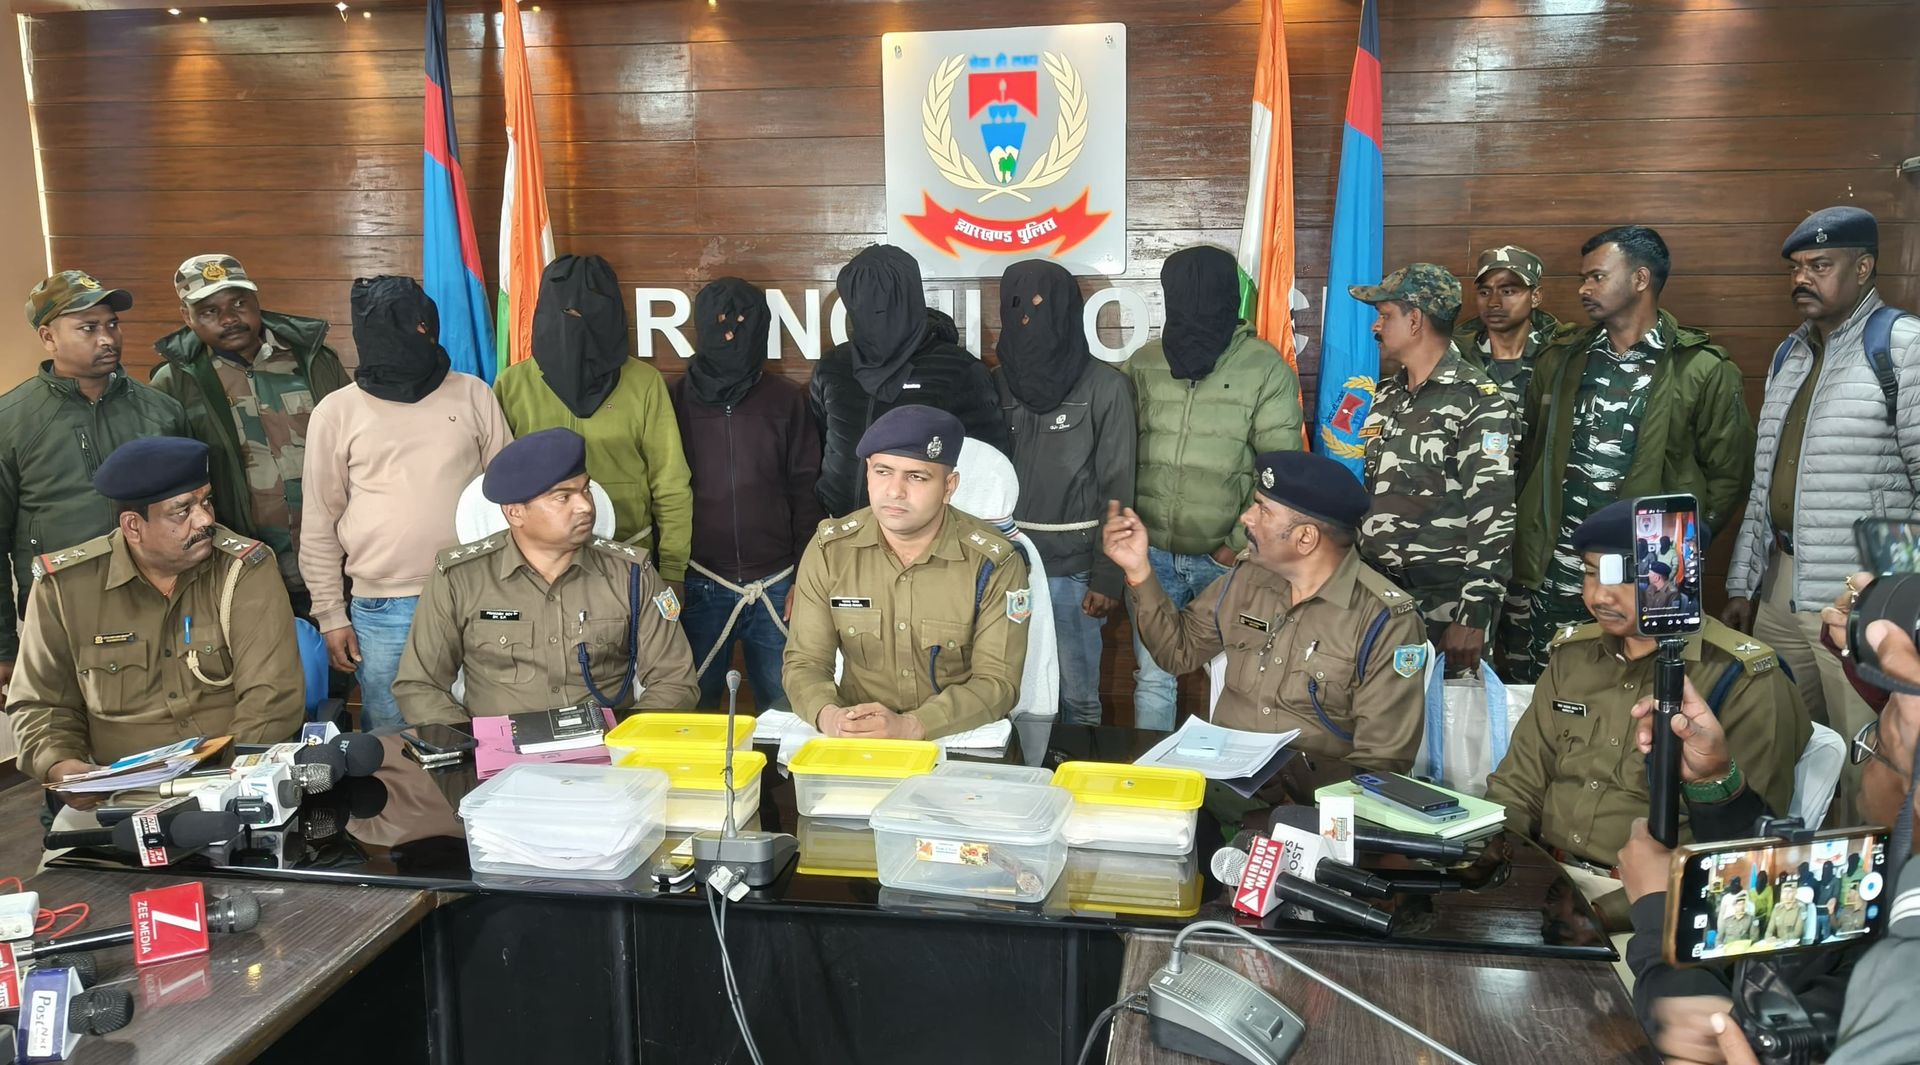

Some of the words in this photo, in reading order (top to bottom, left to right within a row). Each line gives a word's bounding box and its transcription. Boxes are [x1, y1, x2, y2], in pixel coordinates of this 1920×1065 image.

[1016, 216, 1058, 245] पुलिस
[1243, 837, 1270, 891] MIRROR
[1255, 845, 1278, 890] MEDIA
[1289, 845, 1305, 871] OST
[137, 900, 149, 920] ZEE
[139, 920, 152, 955] MEDIA
